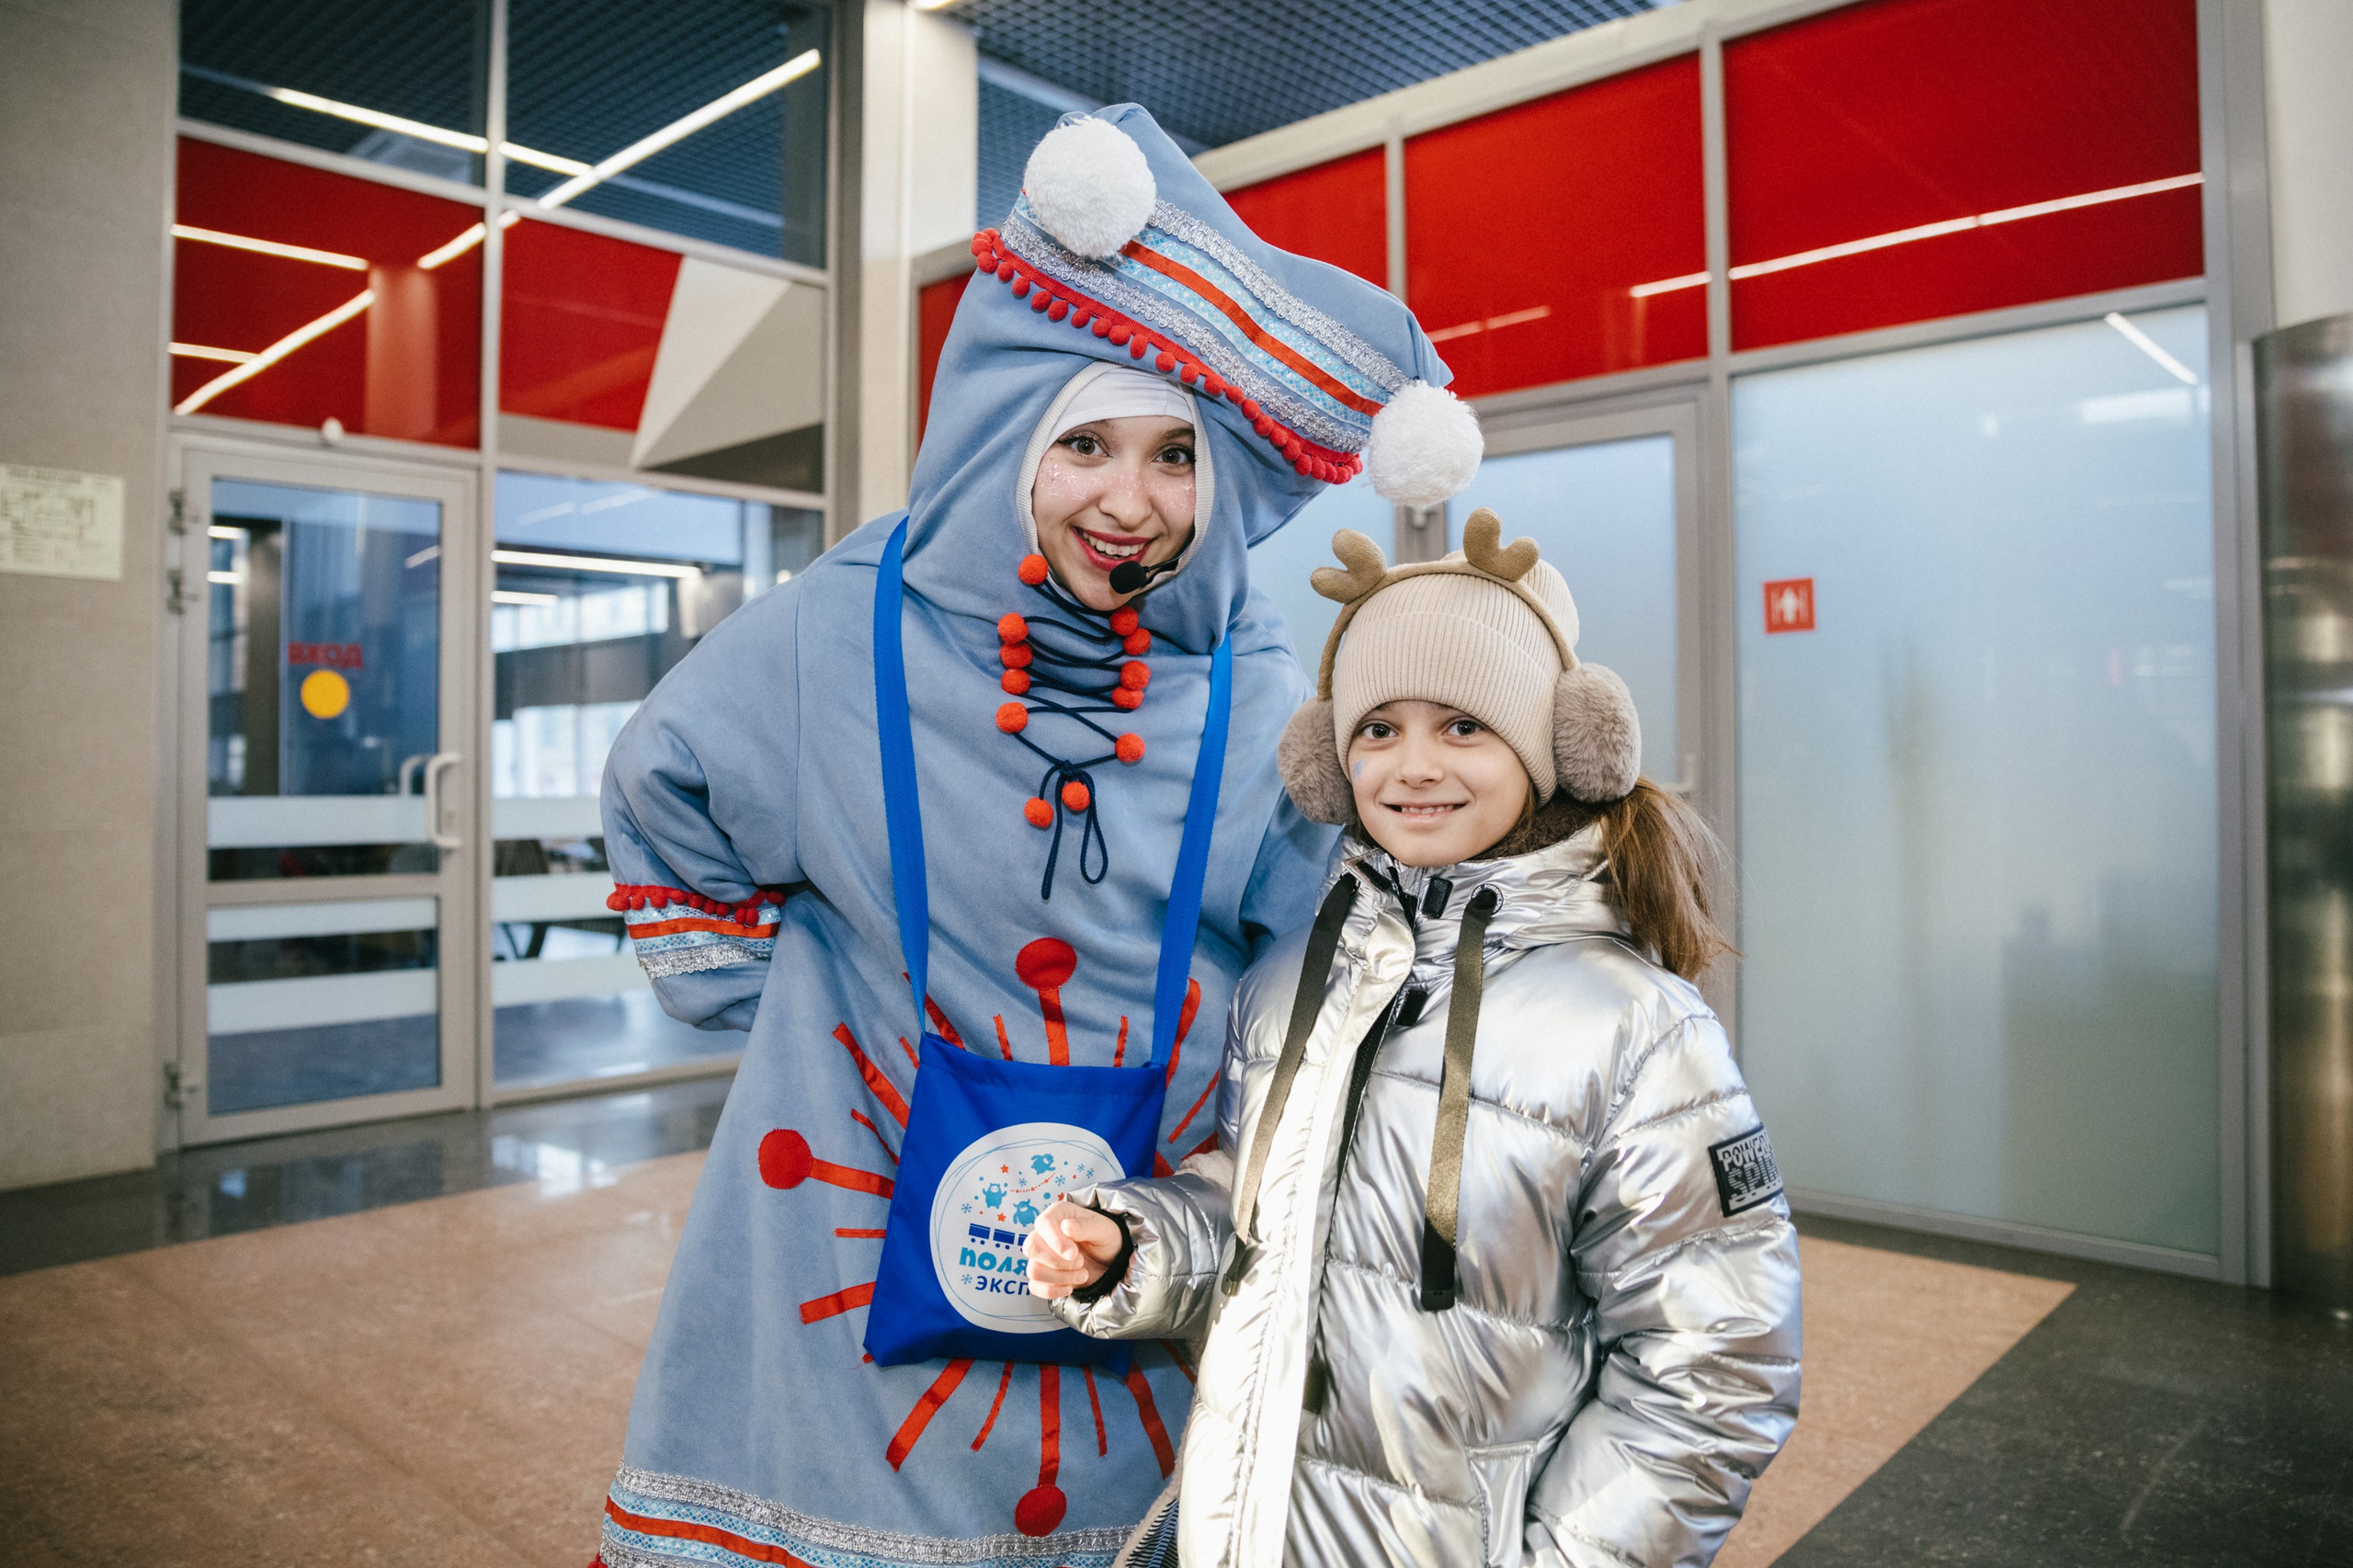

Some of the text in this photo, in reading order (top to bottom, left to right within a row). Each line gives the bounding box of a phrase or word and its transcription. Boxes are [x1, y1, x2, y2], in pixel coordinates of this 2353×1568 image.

[1722, 1133, 1773, 1172] POWER
[1728, 1153, 1780, 1202] SPIR
[959, 1246, 1029, 1277] ПОЛЯ
[975, 1275, 1030, 1296] ЭКСП
